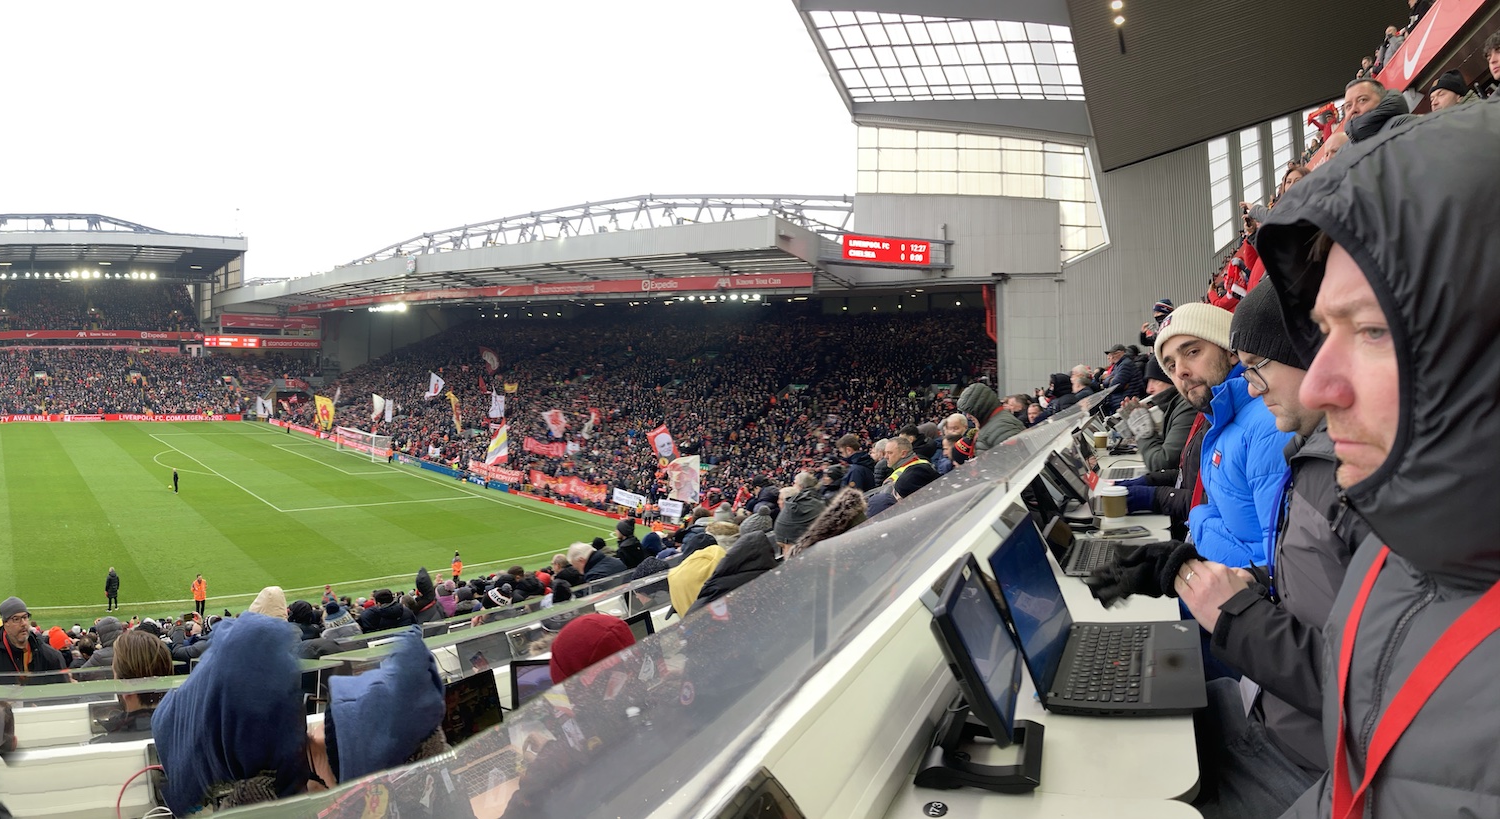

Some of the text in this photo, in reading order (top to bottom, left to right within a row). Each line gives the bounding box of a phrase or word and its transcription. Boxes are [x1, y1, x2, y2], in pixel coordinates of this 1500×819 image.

[848, 240, 881, 249] LIVERPOOL
[882, 242, 890, 250] FC
[910, 244, 926, 252] 12:27
[848, 249, 876, 258] CHELSEA
[650, 281, 678, 290] Expedia
[714, 277, 731, 287] AXA
[929, 802, 943, 815] 173
